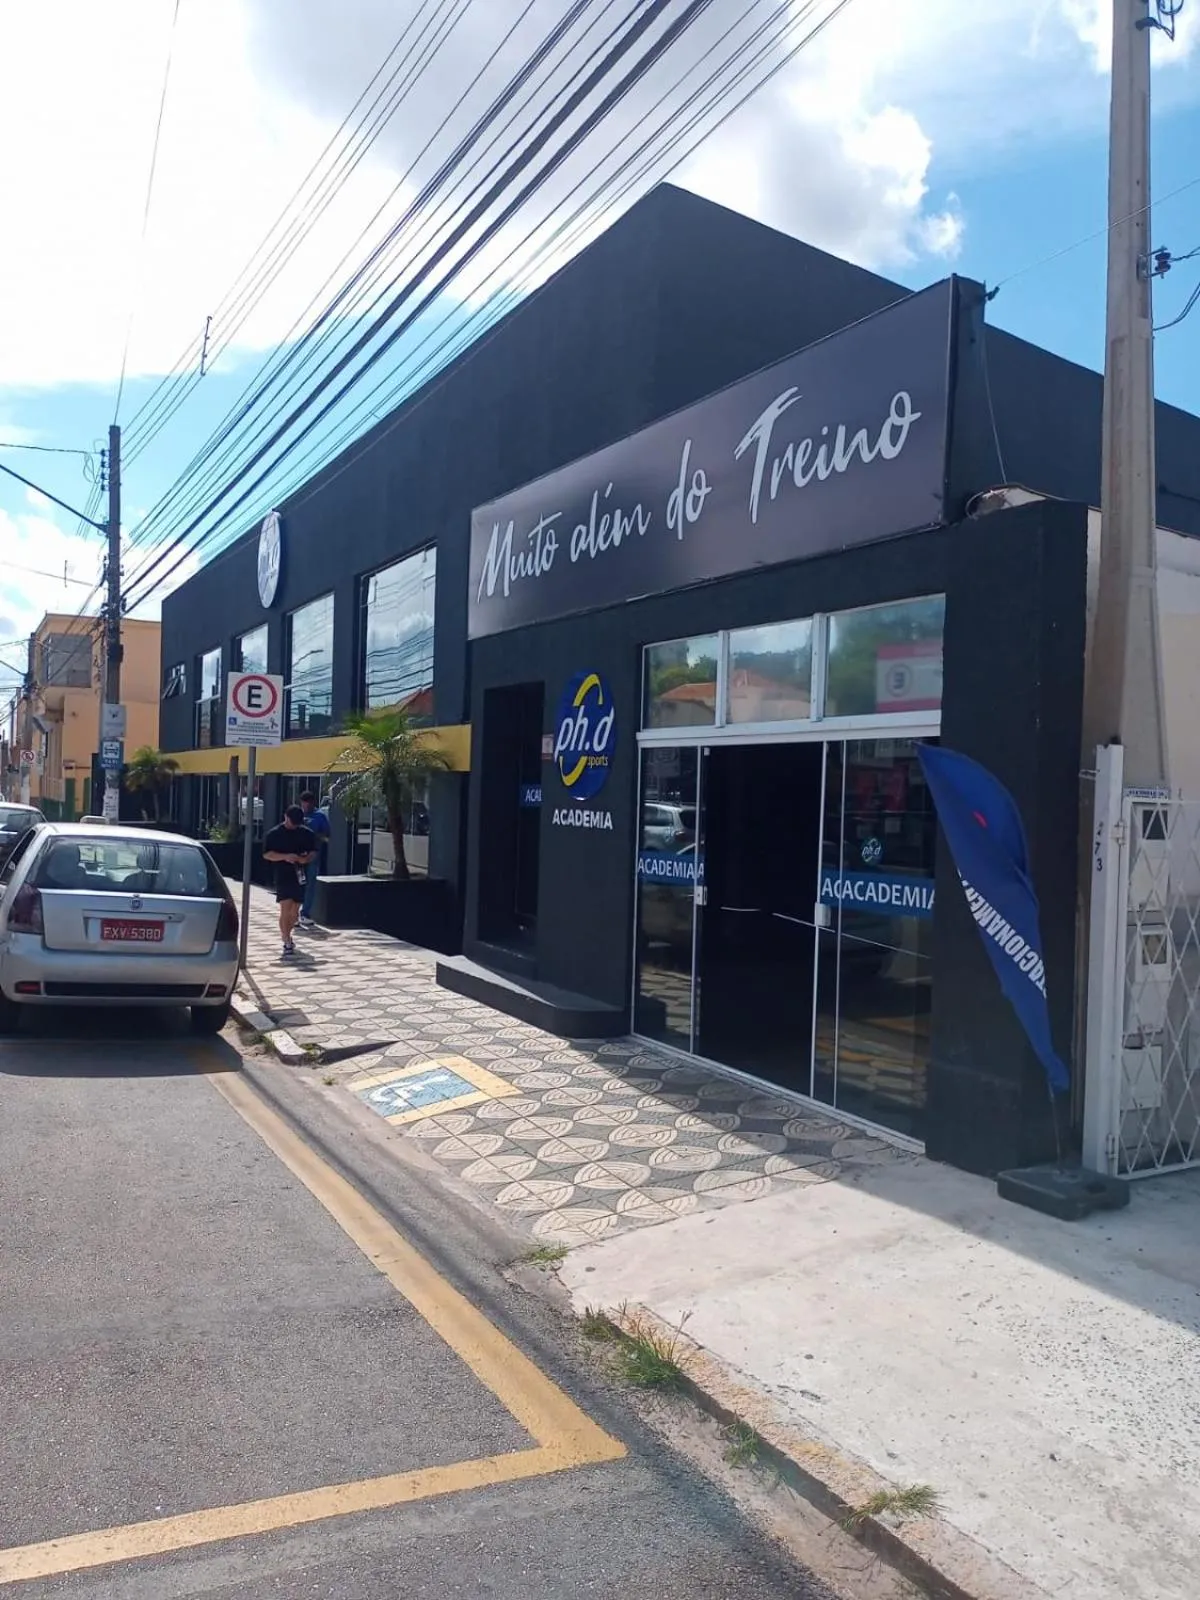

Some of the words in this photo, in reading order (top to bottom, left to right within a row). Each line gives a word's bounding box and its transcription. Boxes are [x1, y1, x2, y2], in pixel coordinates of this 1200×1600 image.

[477, 511, 562, 603] Muito
[571, 482, 651, 562] além
[665, 439, 711, 540] do
[734, 386, 921, 524] Treino
[247, 685, 262, 708] E
[554, 705, 615, 762] ph.d
[552, 809, 613, 830] ACADEMIA
[638, 858, 694, 879] ACADEMIA
[104, 927, 127, 939] FXV
